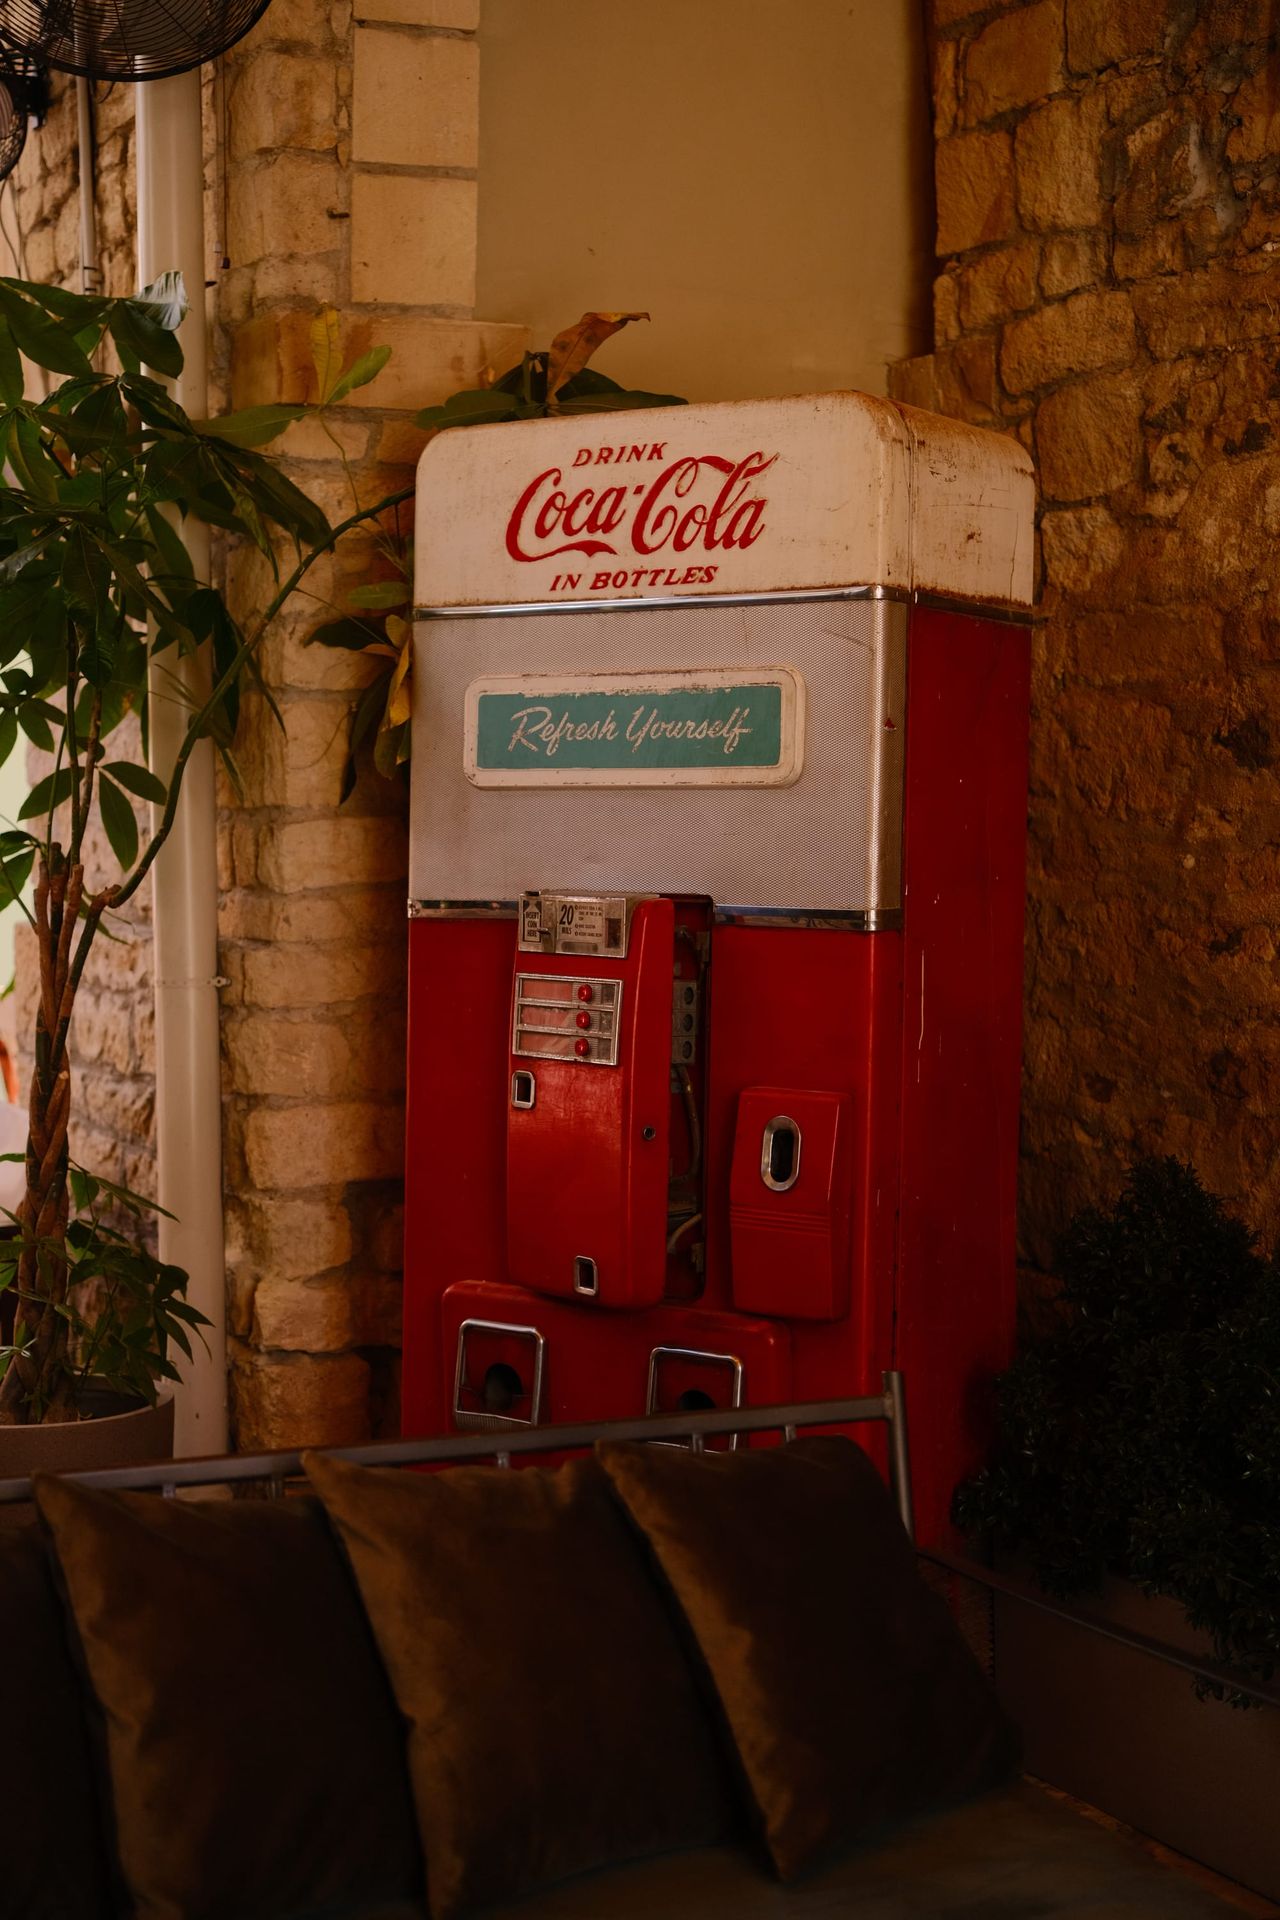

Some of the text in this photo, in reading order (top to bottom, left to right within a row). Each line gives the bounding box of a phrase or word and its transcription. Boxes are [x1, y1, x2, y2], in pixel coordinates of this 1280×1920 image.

[571, 442, 668, 467] DRINK
[549, 565, 719, 592] IN BOTTLES
[507, 705, 752, 756] Refresh Yourself
[527, 920, 538, 928] COIN
[559, 904, 575, 926] 20
